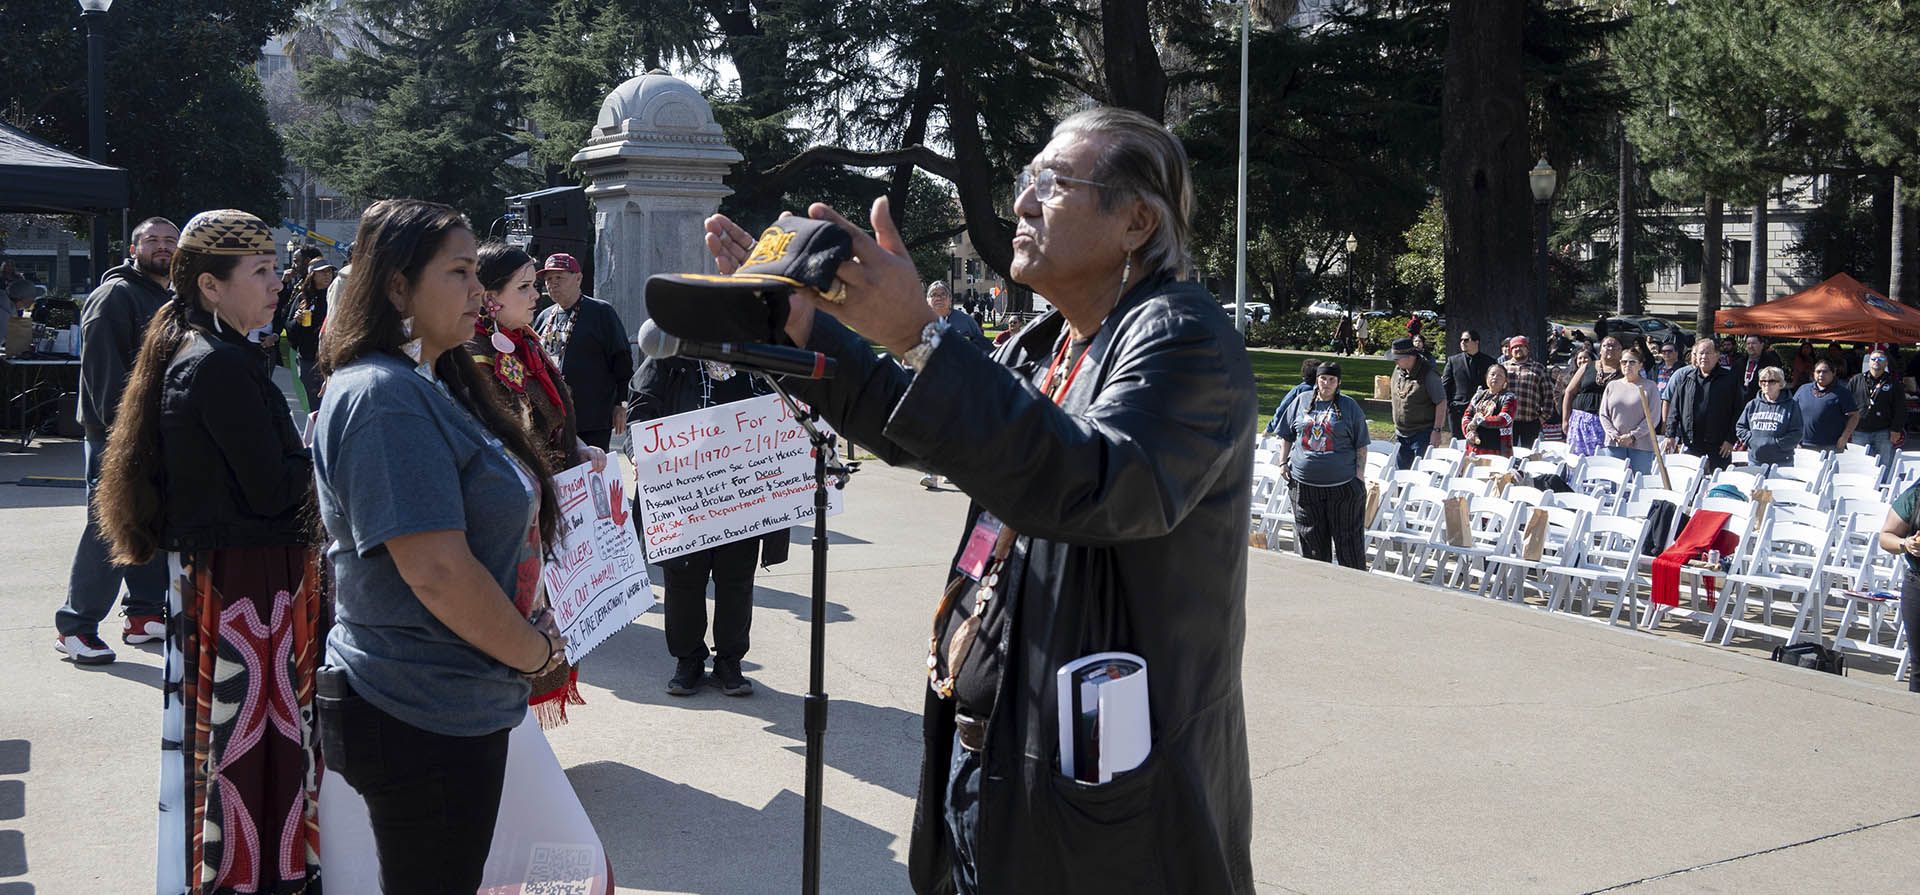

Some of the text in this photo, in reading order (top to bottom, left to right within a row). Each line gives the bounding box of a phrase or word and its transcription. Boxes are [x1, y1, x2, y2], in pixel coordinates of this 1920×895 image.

[643, 422, 726, 453] Justice
[735, 411, 767, 433] For
[1752, 421, 1778, 431] MINES
[642, 480, 673, 494] Found
[676, 473, 705, 486] Across
[706, 467, 727, 479] From
[729, 463, 745, 472] Sac
[645, 491, 693, 511] Assaulted
[703, 481, 728, 496] Left
[731, 475, 751, 487] For
[646, 522, 668, 536] CHP,
[687, 514, 706, 524] Fire
[708, 494, 767, 518] Department
[649, 511, 675, 524] John
[678, 503, 700, 515] Had
[701, 493, 735, 508] Broken
[738, 485, 764, 499] Bones
[772, 476, 802, 489] Severe
[648, 545, 684, 560] Citizen
[685, 539, 697, 551] of
[698, 533, 723, 547] Ione
[723, 525, 748, 539] Band
[748, 521, 761, 532] of
[762, 513, 791, 528] Miwok
[545, 540, 593, 594] MY KILLERS
[560, 597, 575, 626] ARE
[566, 629, 581, 660] SAC
[579, 613, 597, 642] FIRE
